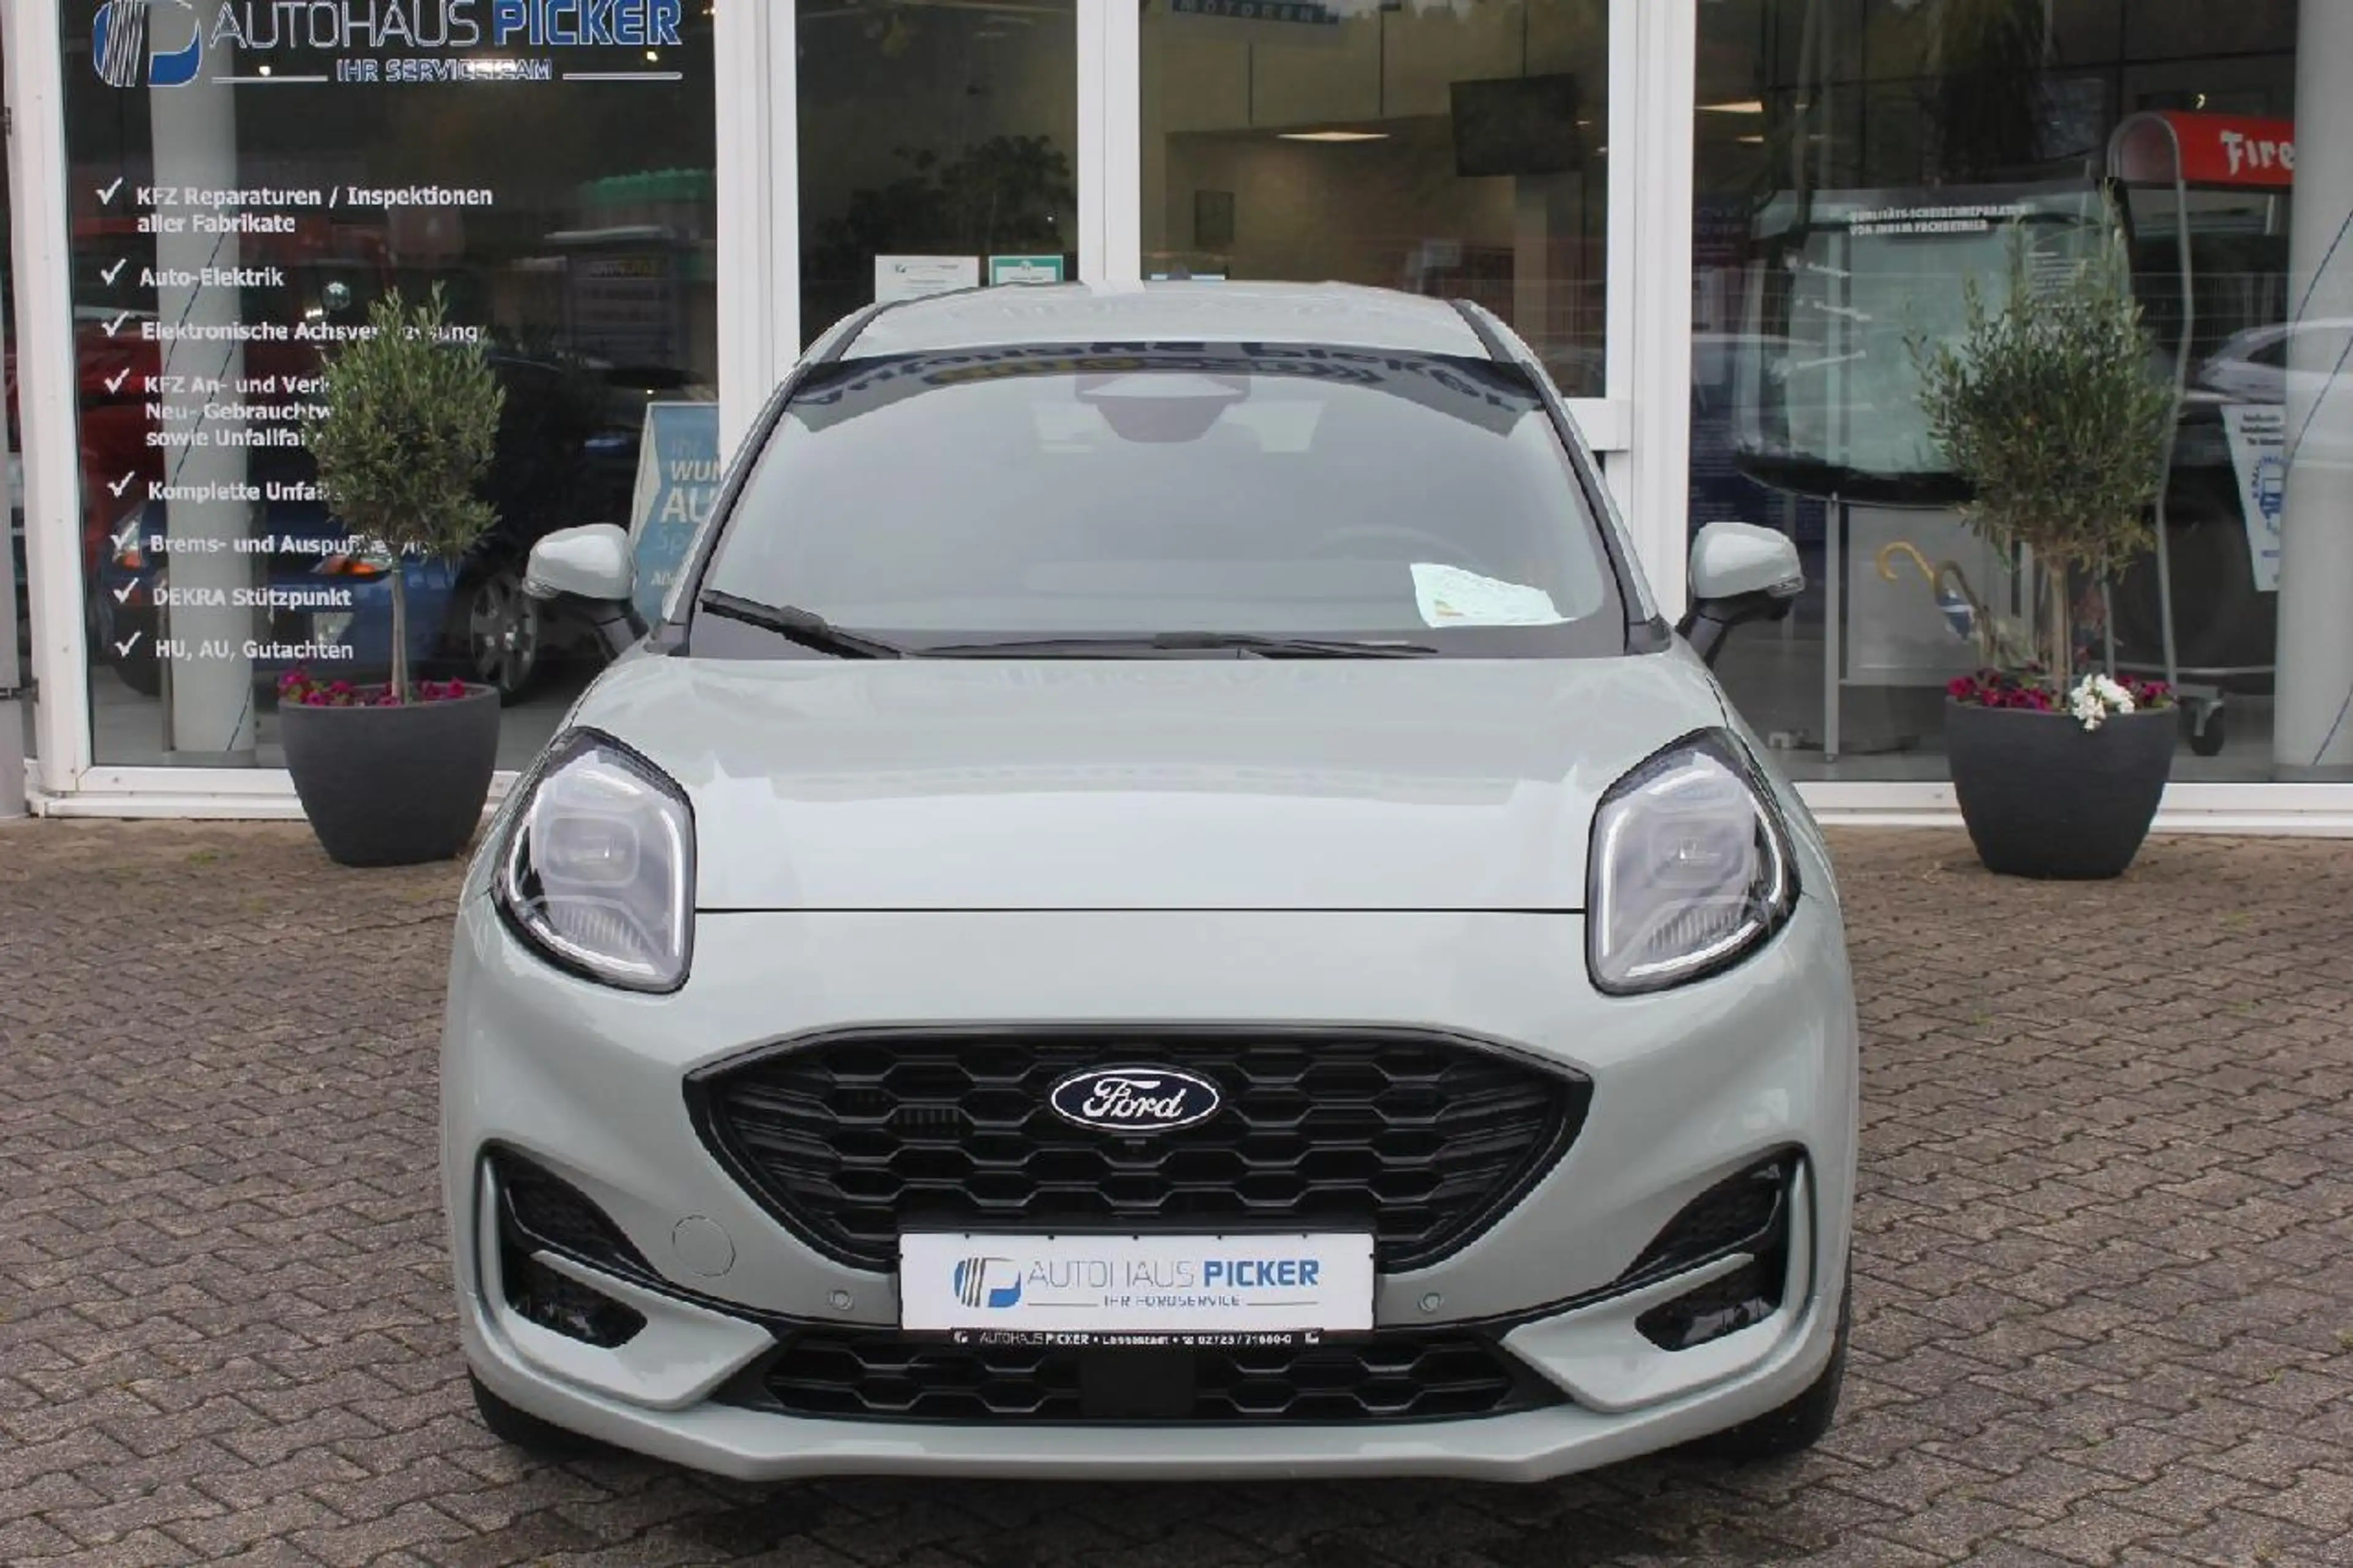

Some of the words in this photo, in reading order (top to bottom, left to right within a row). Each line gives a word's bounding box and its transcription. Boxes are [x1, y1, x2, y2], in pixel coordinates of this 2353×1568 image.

[209, 1, 479, 49] AUTOHAUS
[493, 0, 683, 46] PICKER
[336, 59, 379, 82] IHR
[137, 187, 178, 206] KFZ
[186, 187, 321, 209] Reparaturen
[347, 186, 493, 209] Inspektionen
[137, 214, 186, 233] aller
[192, 214, 296, 233] Fabrikate
[139, 267, 286, 287] Auto-Elektrik
[142, 321, 289, 340] Elektronische
[144, 376, 184, 393] KFZ
[191, 376, 228, 393] An-
[236, 375, 275, 393] und
[145, 404, 197, 420] Neu-
[146, 429, 208, 447] sowie
[148, 481, 260, 504] Komplette
[151, 535, 227, 553] Brems-
[233, 534, 275, 553] und
[153, 588, 226, 607] DEKRA
[232, 586, 353, 611] Stützpunkt
[156, 640, 192, 662] HU,
[199, 641, 235, 662] AU,
[242, 639, 354, 660] Gutachten
[1082, 1077, 1187, 1118] Ford
[1027, 1260, 1194, 1288] AUTOHAUS
[1203, 1259, 1320, 1287] PICKER
